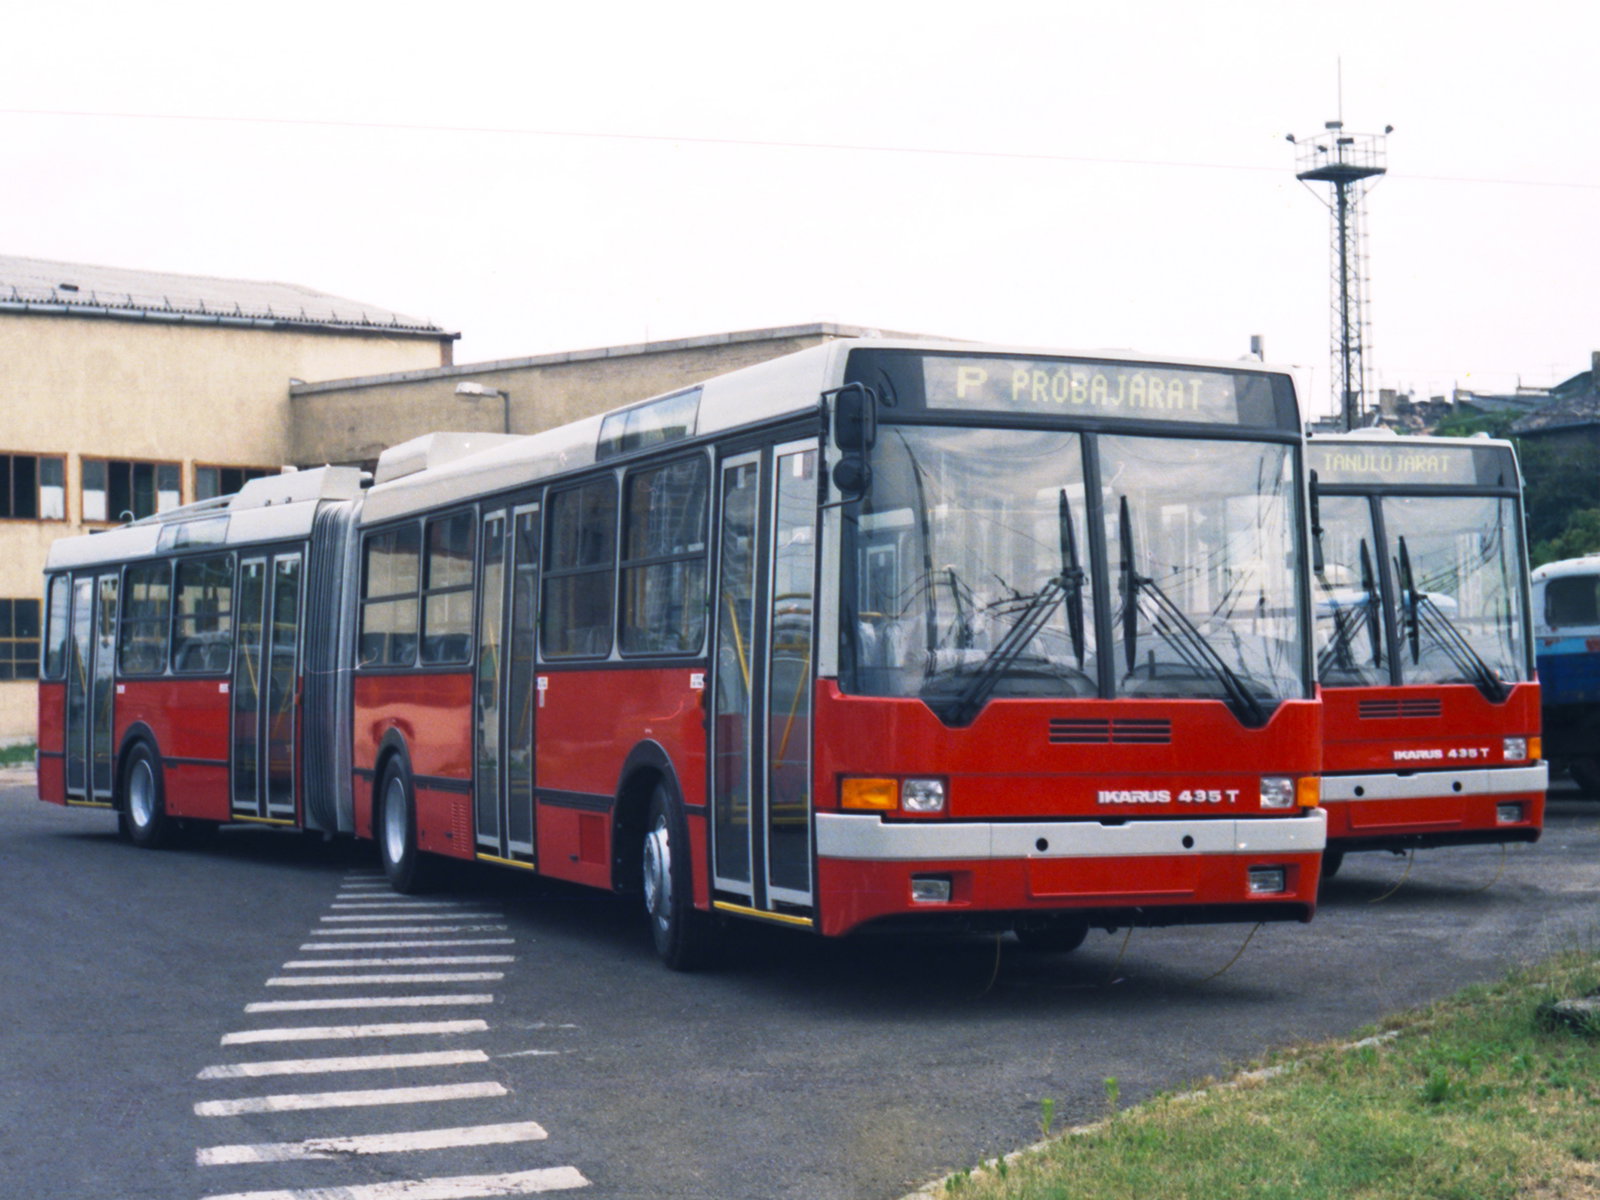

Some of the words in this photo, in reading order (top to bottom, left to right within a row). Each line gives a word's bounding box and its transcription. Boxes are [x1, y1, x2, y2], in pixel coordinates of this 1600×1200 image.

[957, 366, 988, 398] P
[1011, 367, 1202, 410] PRÓBAJÁRAT
[1393, 749, 1443, 760] IKARUS
[1447, 748, 1477, 759] 435
[1098, 790, 1171, 803] IKARUS
[1178, 790, 1221, 803] 435
[1226, 790, 1239, 803] T
